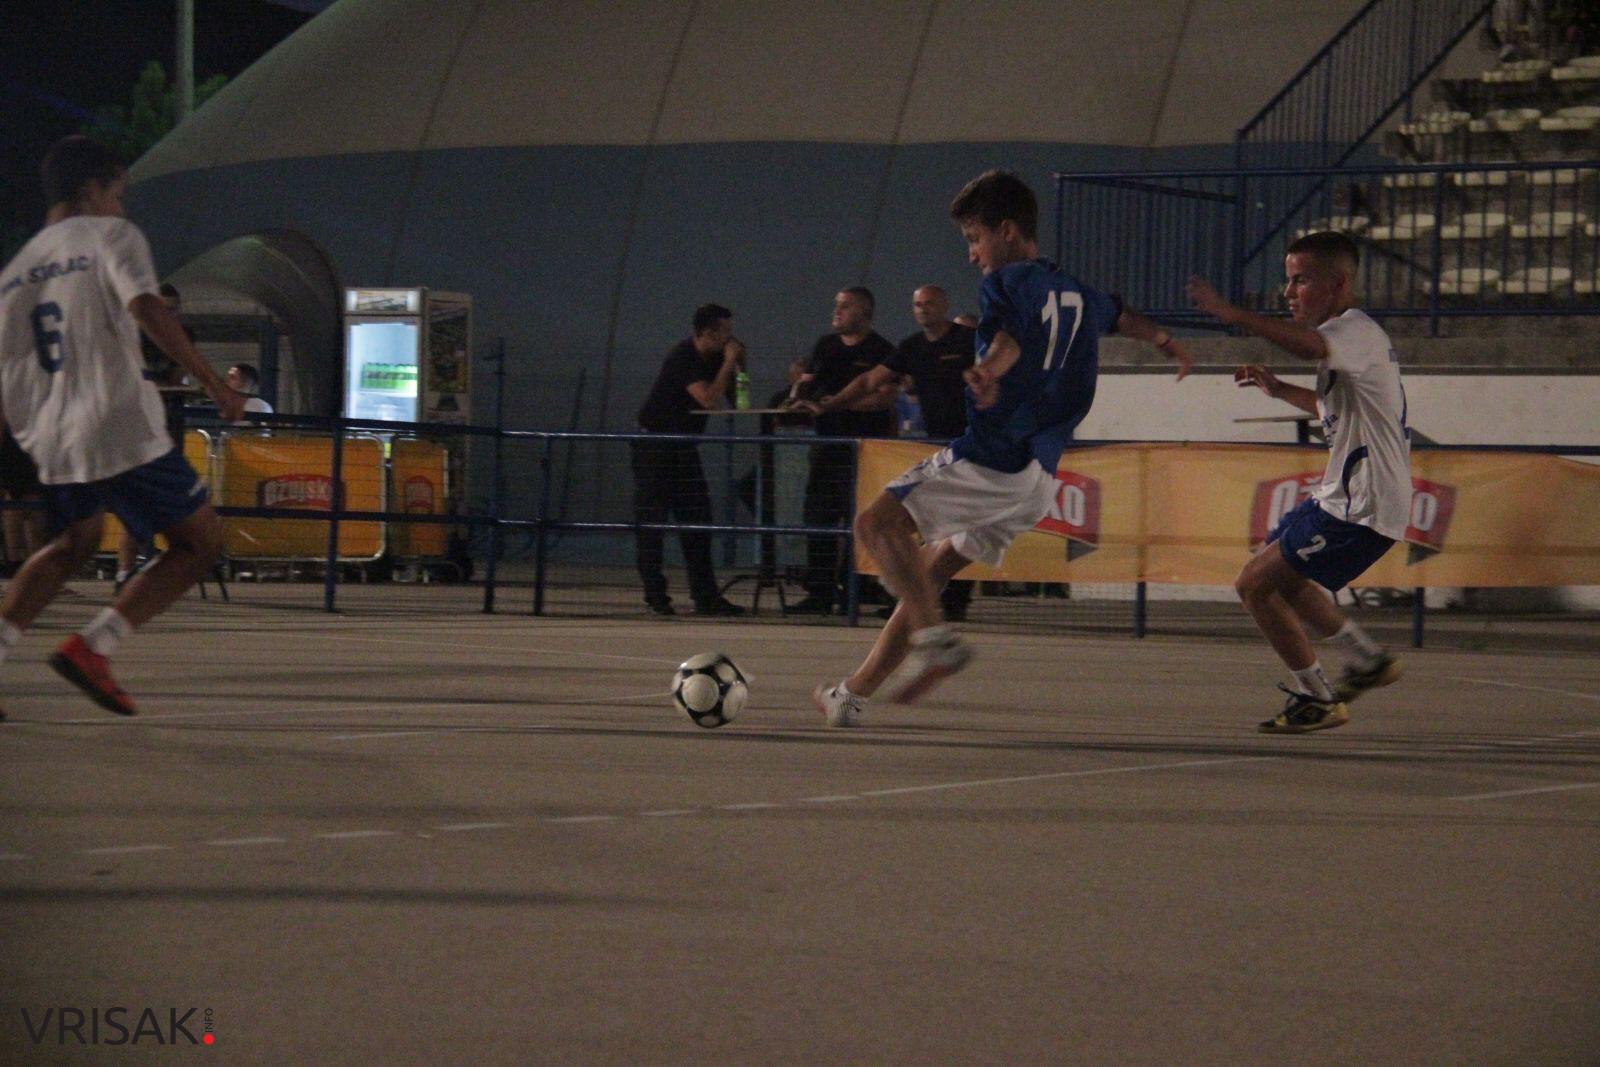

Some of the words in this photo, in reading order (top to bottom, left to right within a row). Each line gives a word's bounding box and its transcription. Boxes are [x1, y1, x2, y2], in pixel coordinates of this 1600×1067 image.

[31, 302, 63, 373] 6
[1041, 290, 1083, 370] 17
[1297, 534, 1327, 562] 2
